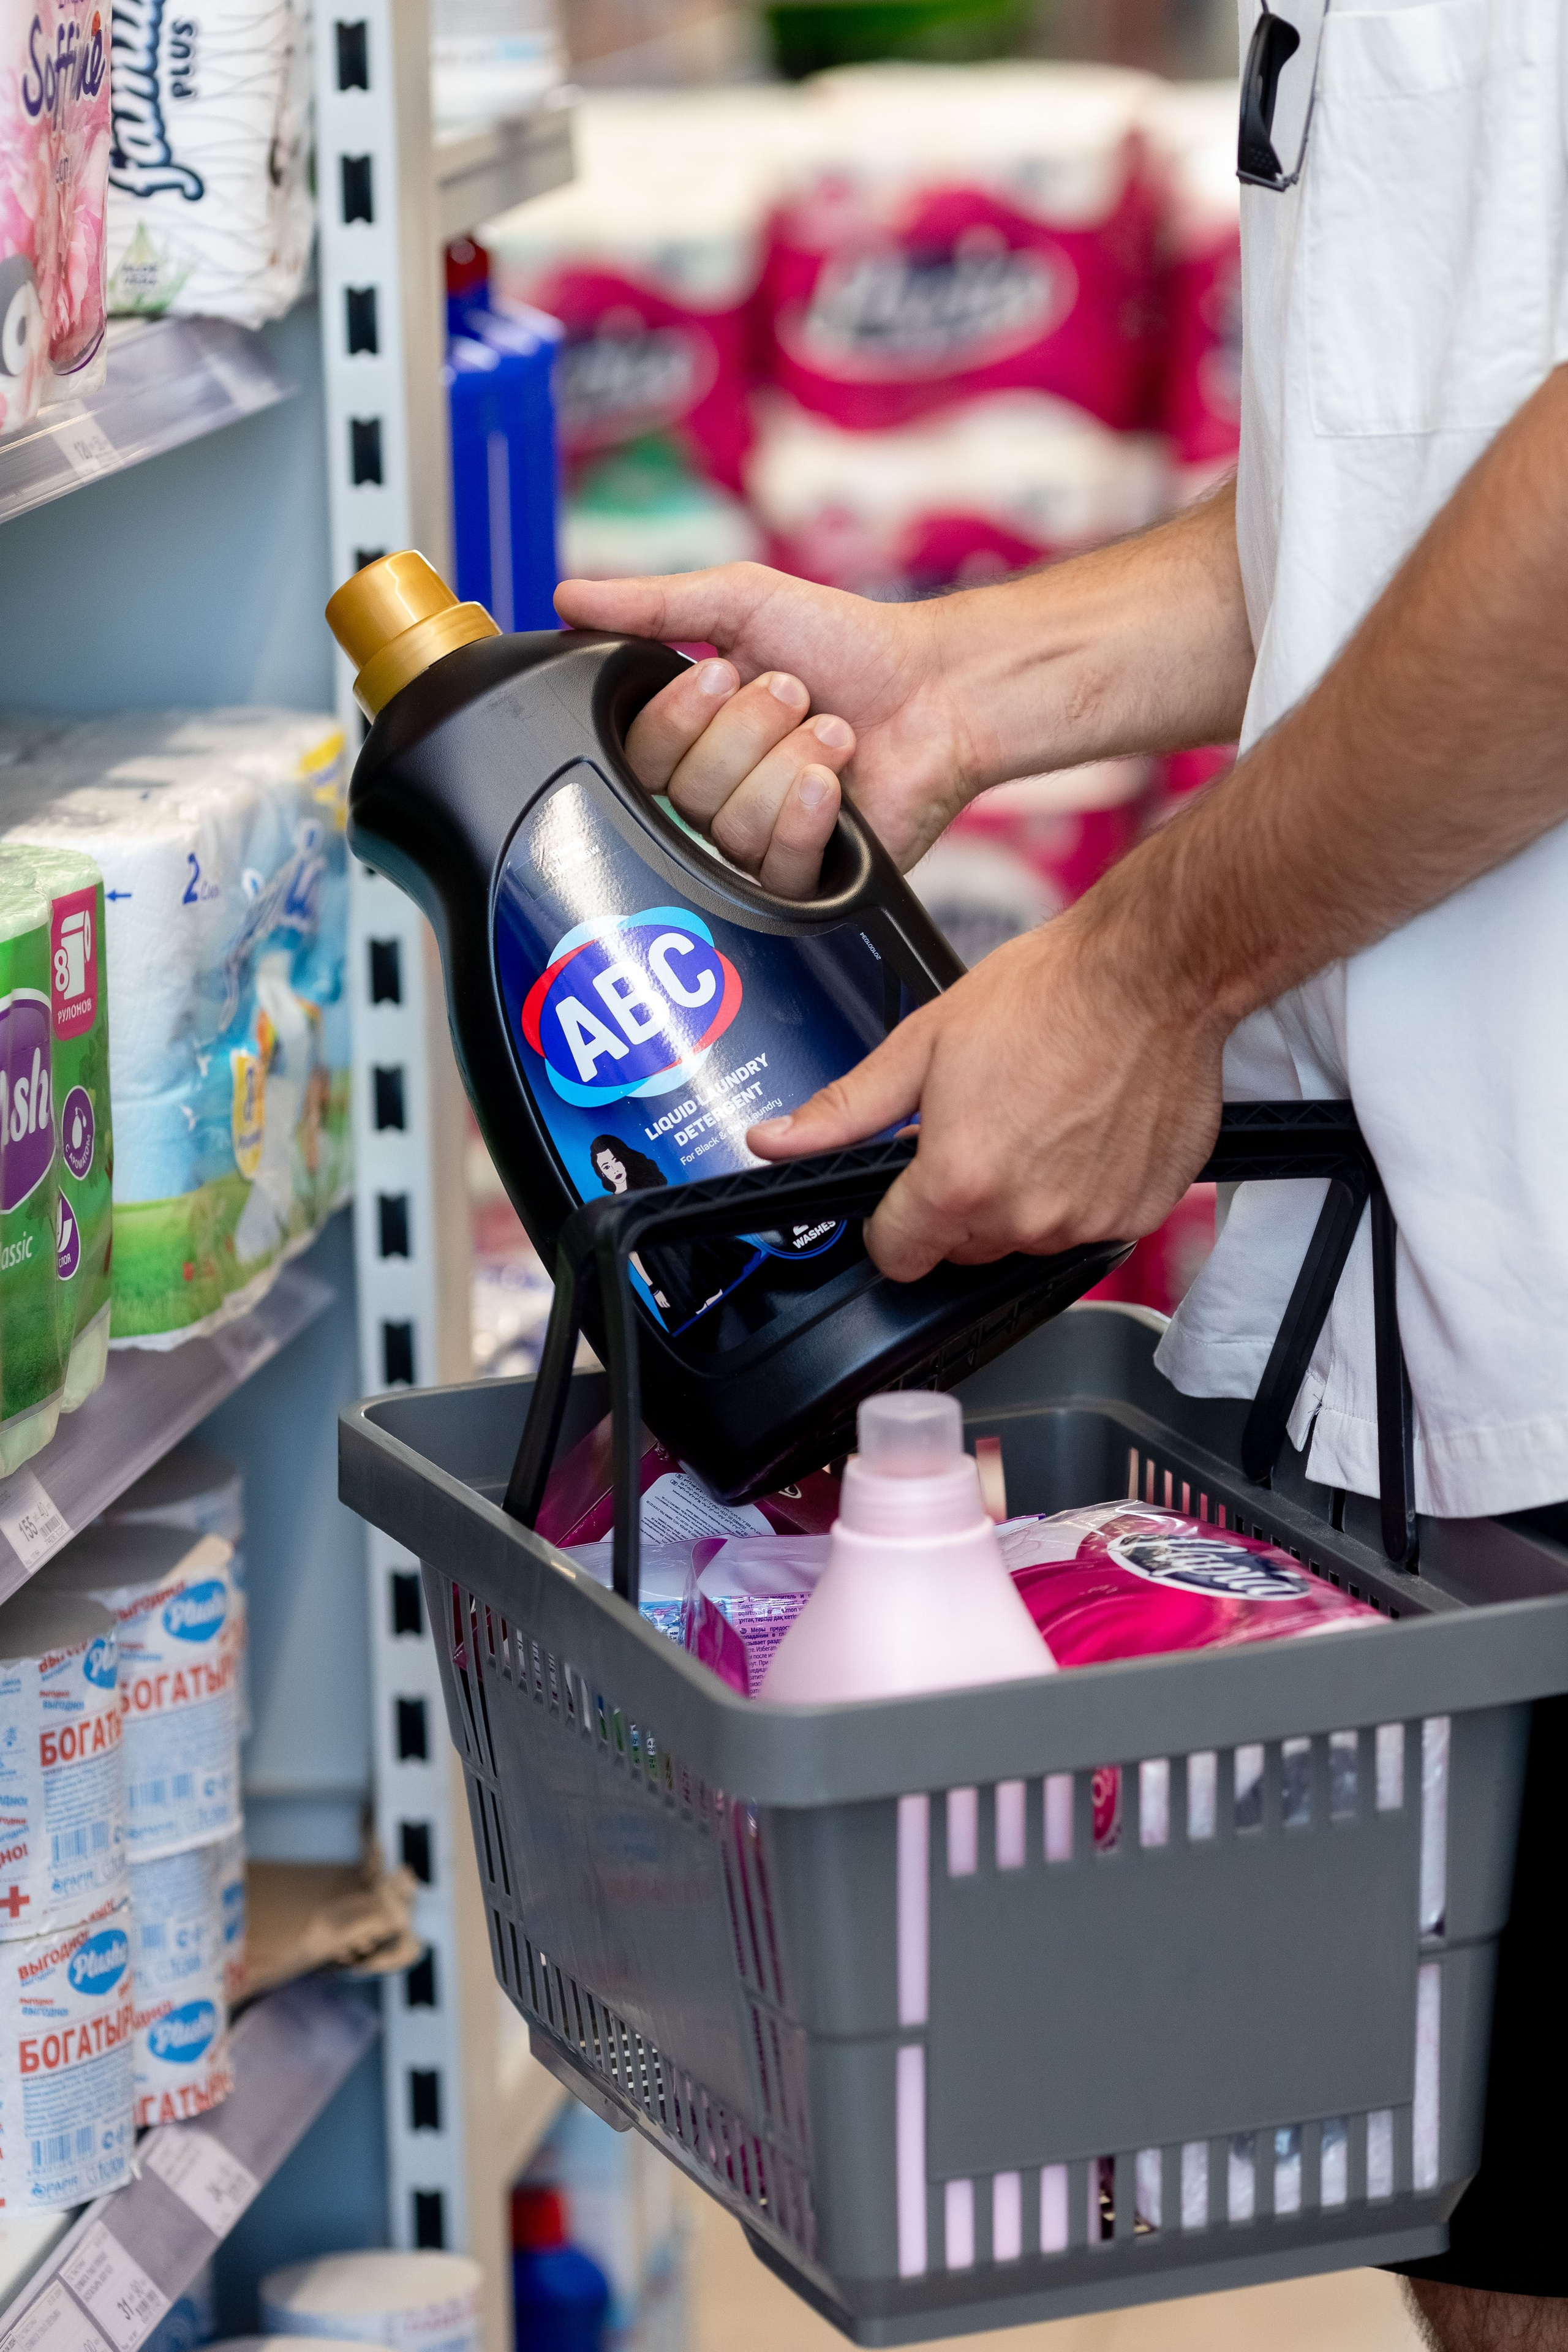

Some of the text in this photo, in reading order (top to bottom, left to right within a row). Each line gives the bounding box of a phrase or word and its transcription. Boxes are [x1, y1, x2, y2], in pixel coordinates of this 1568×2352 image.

[171, 20, 195, 99] PLUS
[183, 853, 200, 903] 2
[859, 932, 881, 960] 201001034
[54, 949, 70, 992] 8
[58, 997, 92, 1025] РУЛОНОВ
[556, 932, 716, 1082] ABC
[644, 1052, 769, 1141] LIQUID LAUNDRY
[673, 1080, 764, 1147] DETERGENT
[69, 1134, 92, 1169] АРОМАТОМ
[680, 1153, 696, 1166] For
[694, 1135, 720, 1156] Black
[718, 1131, 728, 1140] &
[747, 1098, 783, 1123] Laundry
[0, 1231, 33, 1270] assic
[792, 1220, 836, 1249] WASHES
[58, 1253, 72, 1268] СЛОЯ
[18, 1515, 38, 1542] 155
